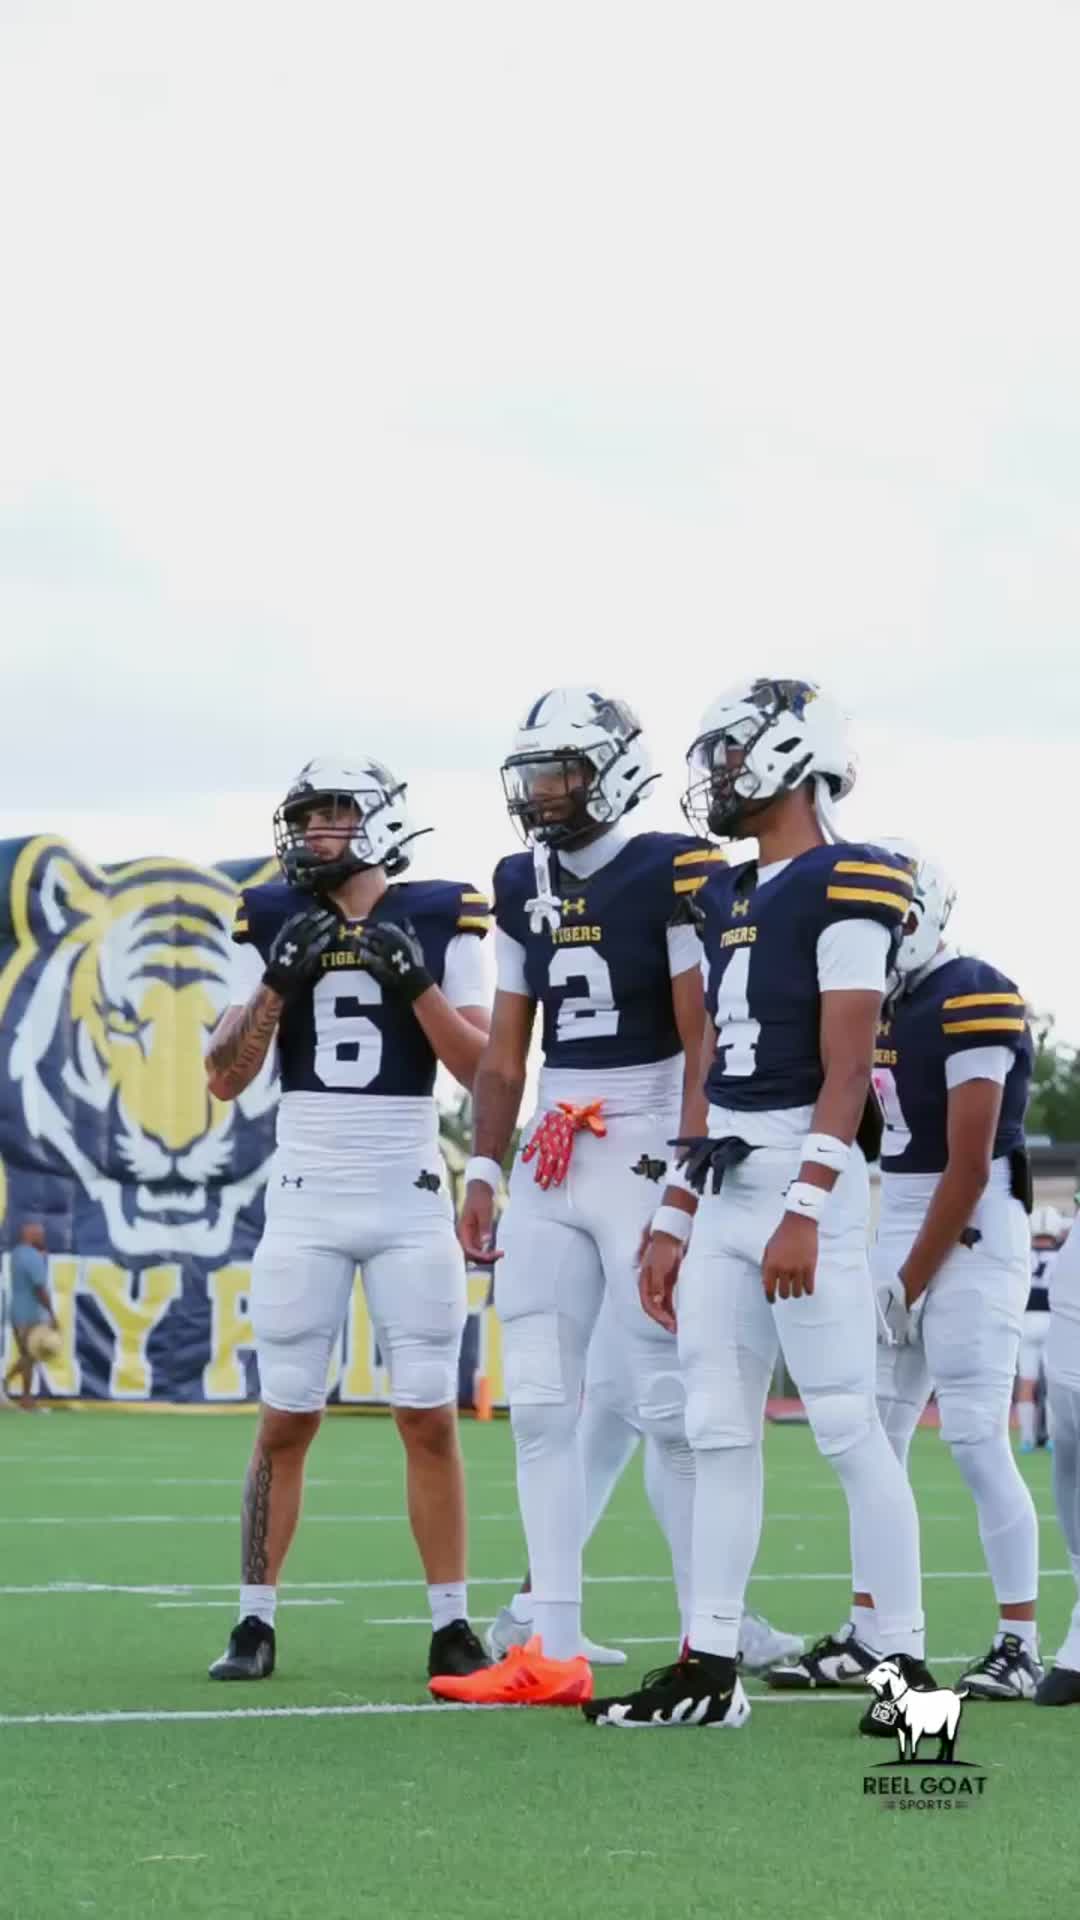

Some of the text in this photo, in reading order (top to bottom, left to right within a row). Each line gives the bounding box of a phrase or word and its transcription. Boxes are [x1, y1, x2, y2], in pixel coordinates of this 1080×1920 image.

[720, 926, 757, 948] TIGERS
[313, 970, 383, 1088] 6
[547, 946, 620, 1042] 2
[714, 947, 761, 1076] 4
